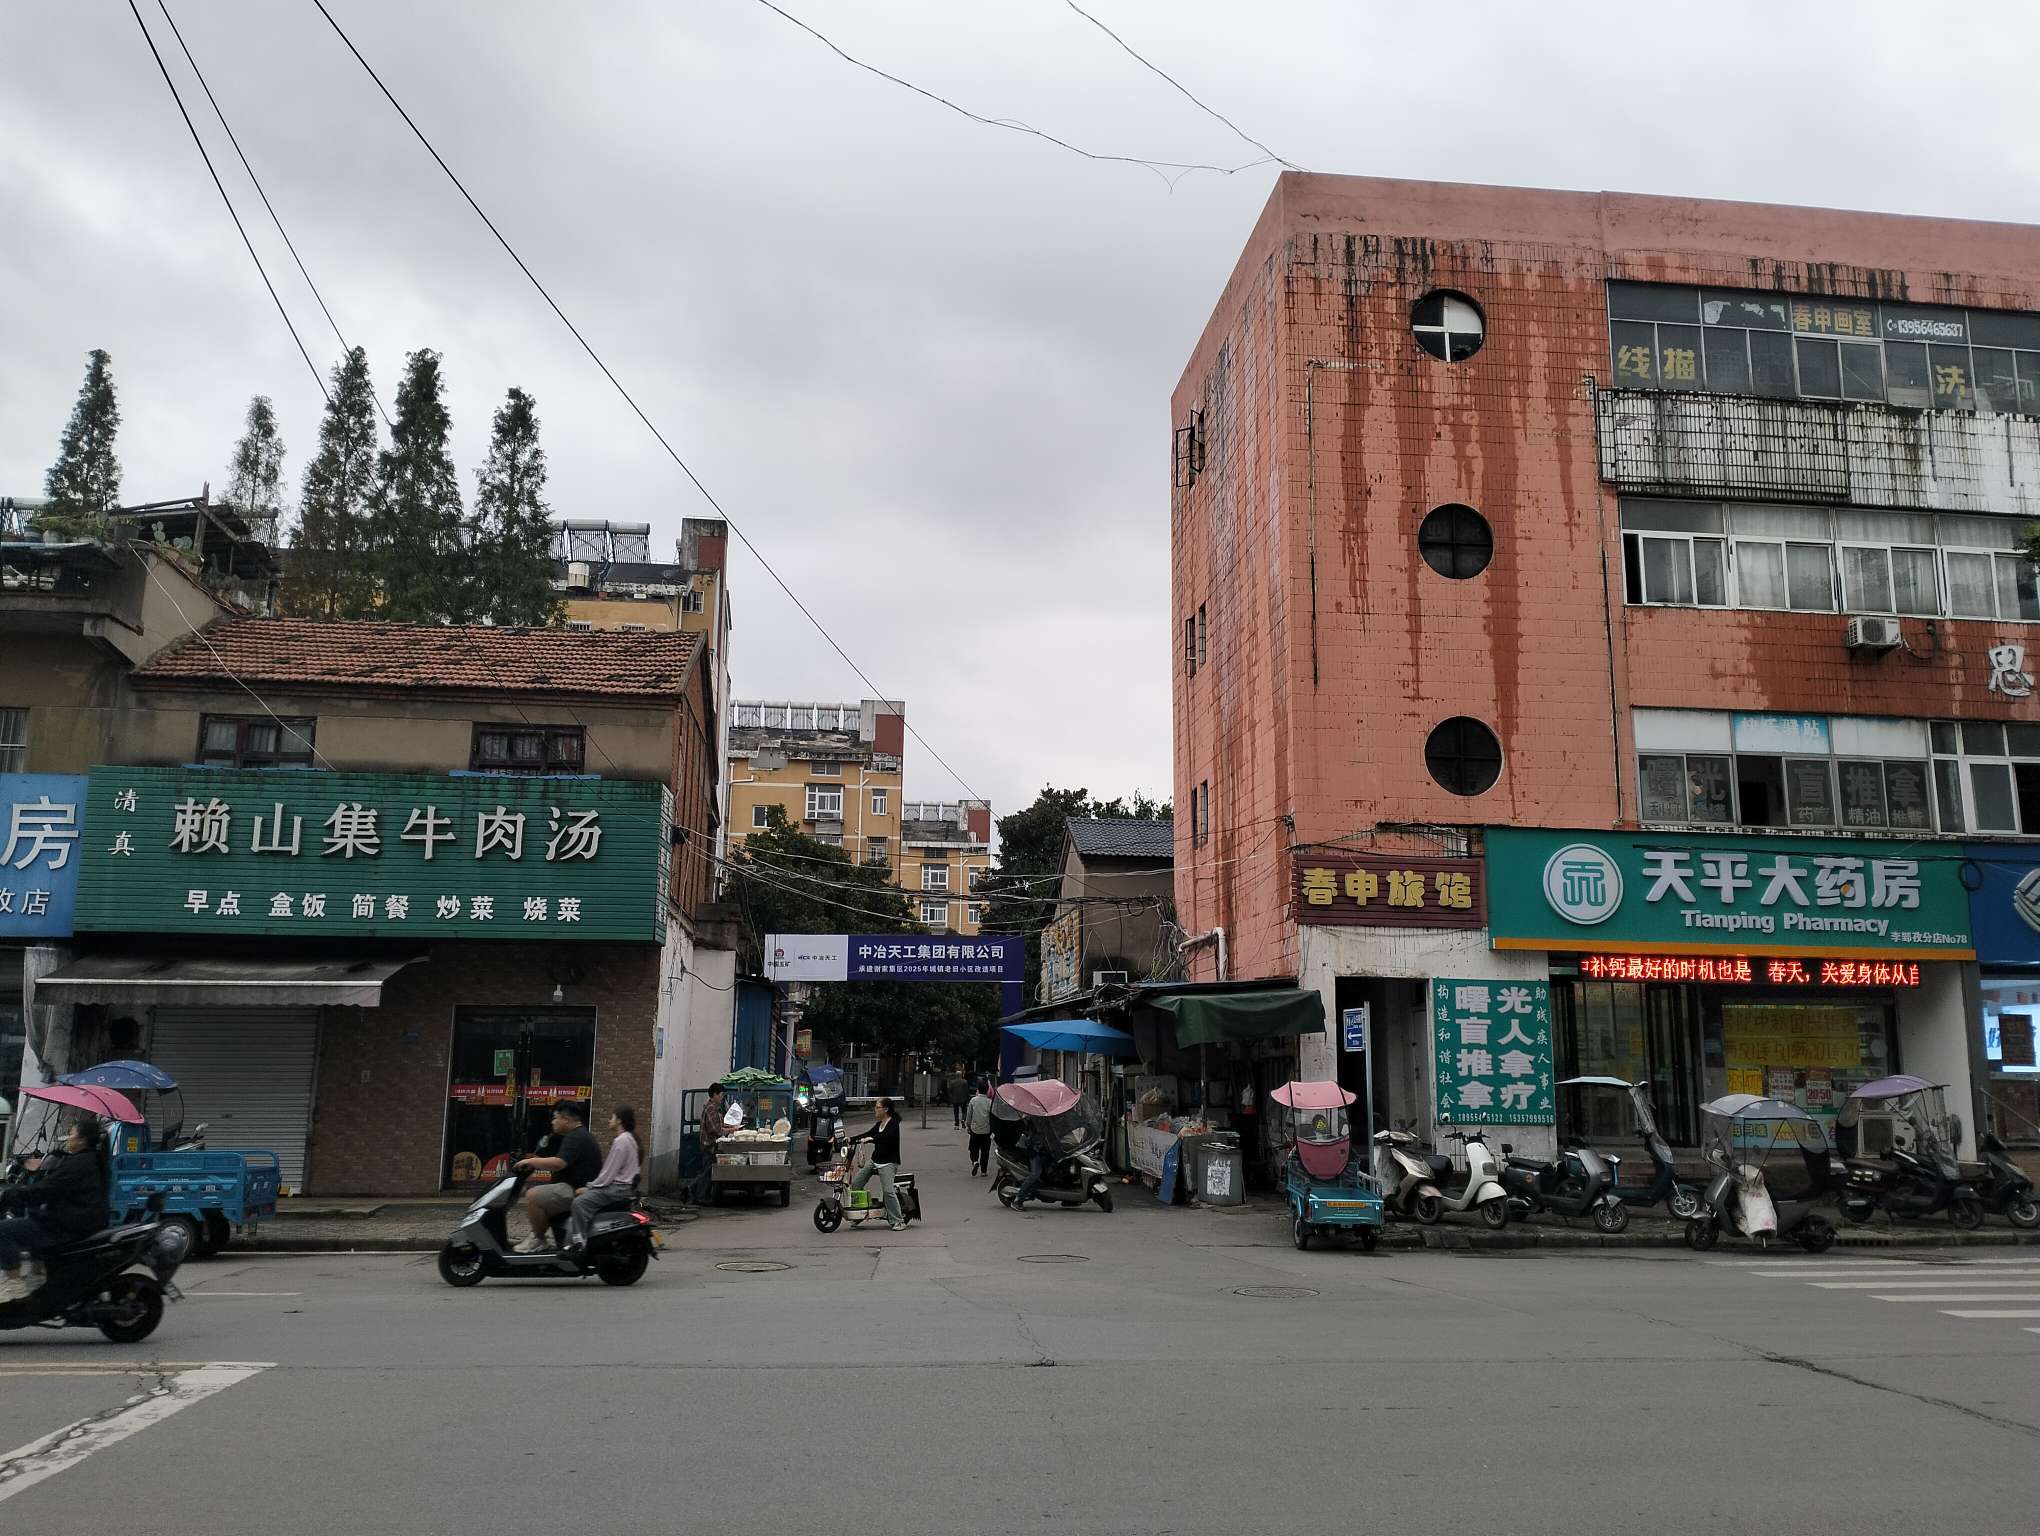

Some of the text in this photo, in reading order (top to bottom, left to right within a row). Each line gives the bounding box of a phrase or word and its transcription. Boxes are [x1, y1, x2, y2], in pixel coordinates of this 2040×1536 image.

[1792, 304, 1874, 337] 春申画室
[0, 795, 79, 871] 房
[108, 787, 140, 857] 清真
[168, 796, 602, 861] 赖山集牛肉汤
[1847, 807, 1882, 825] 精油
[1301, 867, 1472, 909] 春申旅馆
[1641, 851, 1922, 909] 天平大药房
[183, 889, 582, 922] 早点 盒饭 简餐 炒菜 烧菜
[1680, 909, 1891, 937] Tianping Pharmacy
[858, 944, 1005, 960] 中冶天工集团有限公司
